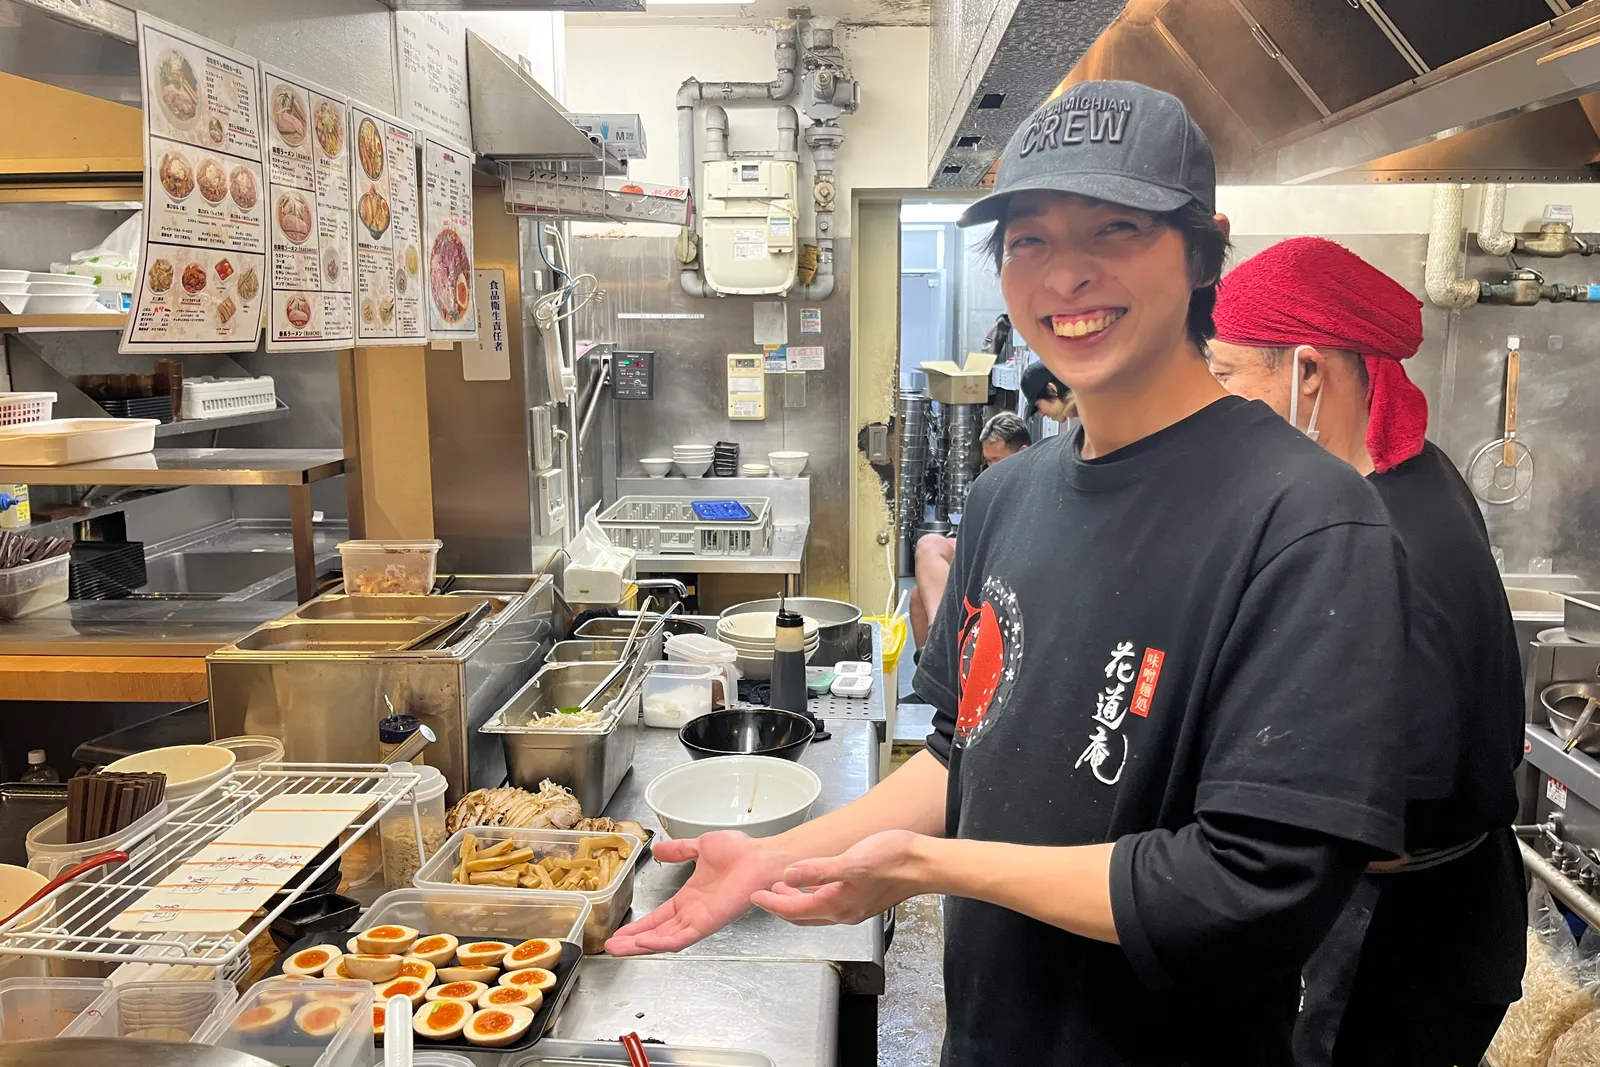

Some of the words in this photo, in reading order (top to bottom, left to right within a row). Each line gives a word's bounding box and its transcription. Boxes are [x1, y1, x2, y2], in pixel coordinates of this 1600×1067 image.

[616, 132, 625, 140] M
[1020, 109, 1129, 158] CREW
[116, 272, 132, 280] Livi
[490, 280, 503, 352] 食品衛生責任者
[1133, 653, 1161, 713] 味噌麺処
[1074, 641, 1135, 785] 花道庵
